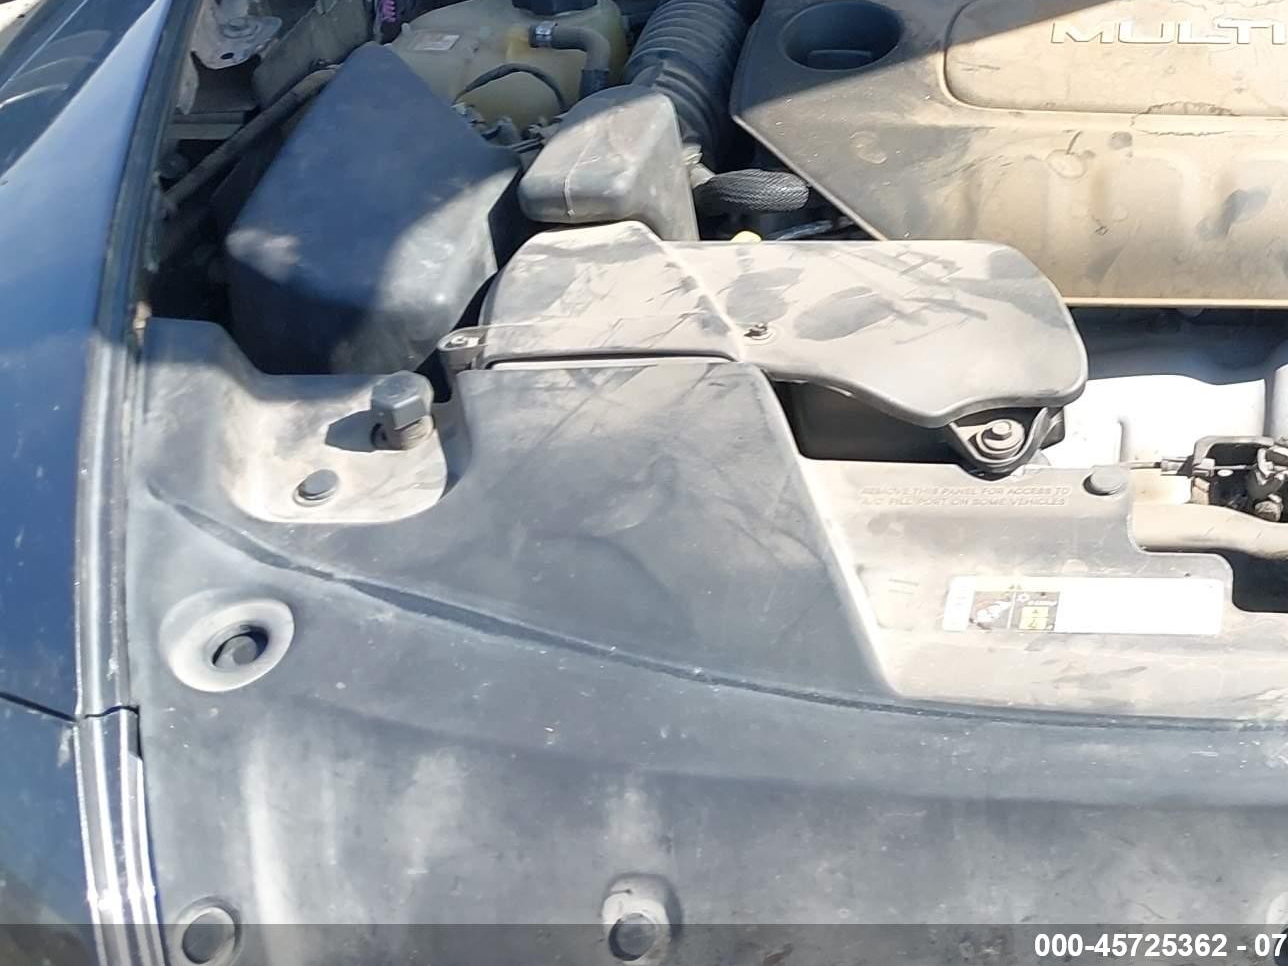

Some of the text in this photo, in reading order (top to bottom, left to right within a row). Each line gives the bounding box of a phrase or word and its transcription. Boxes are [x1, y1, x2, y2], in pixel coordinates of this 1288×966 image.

[982, 487, 1004, 496] FOR
[1006, 487, 1052, 496] ACCESS
[1055, 487, 1071, 496] TO
[971, 497, 1005, 506] SOME
[1010, 497, 1066, 506] VEHICLES
